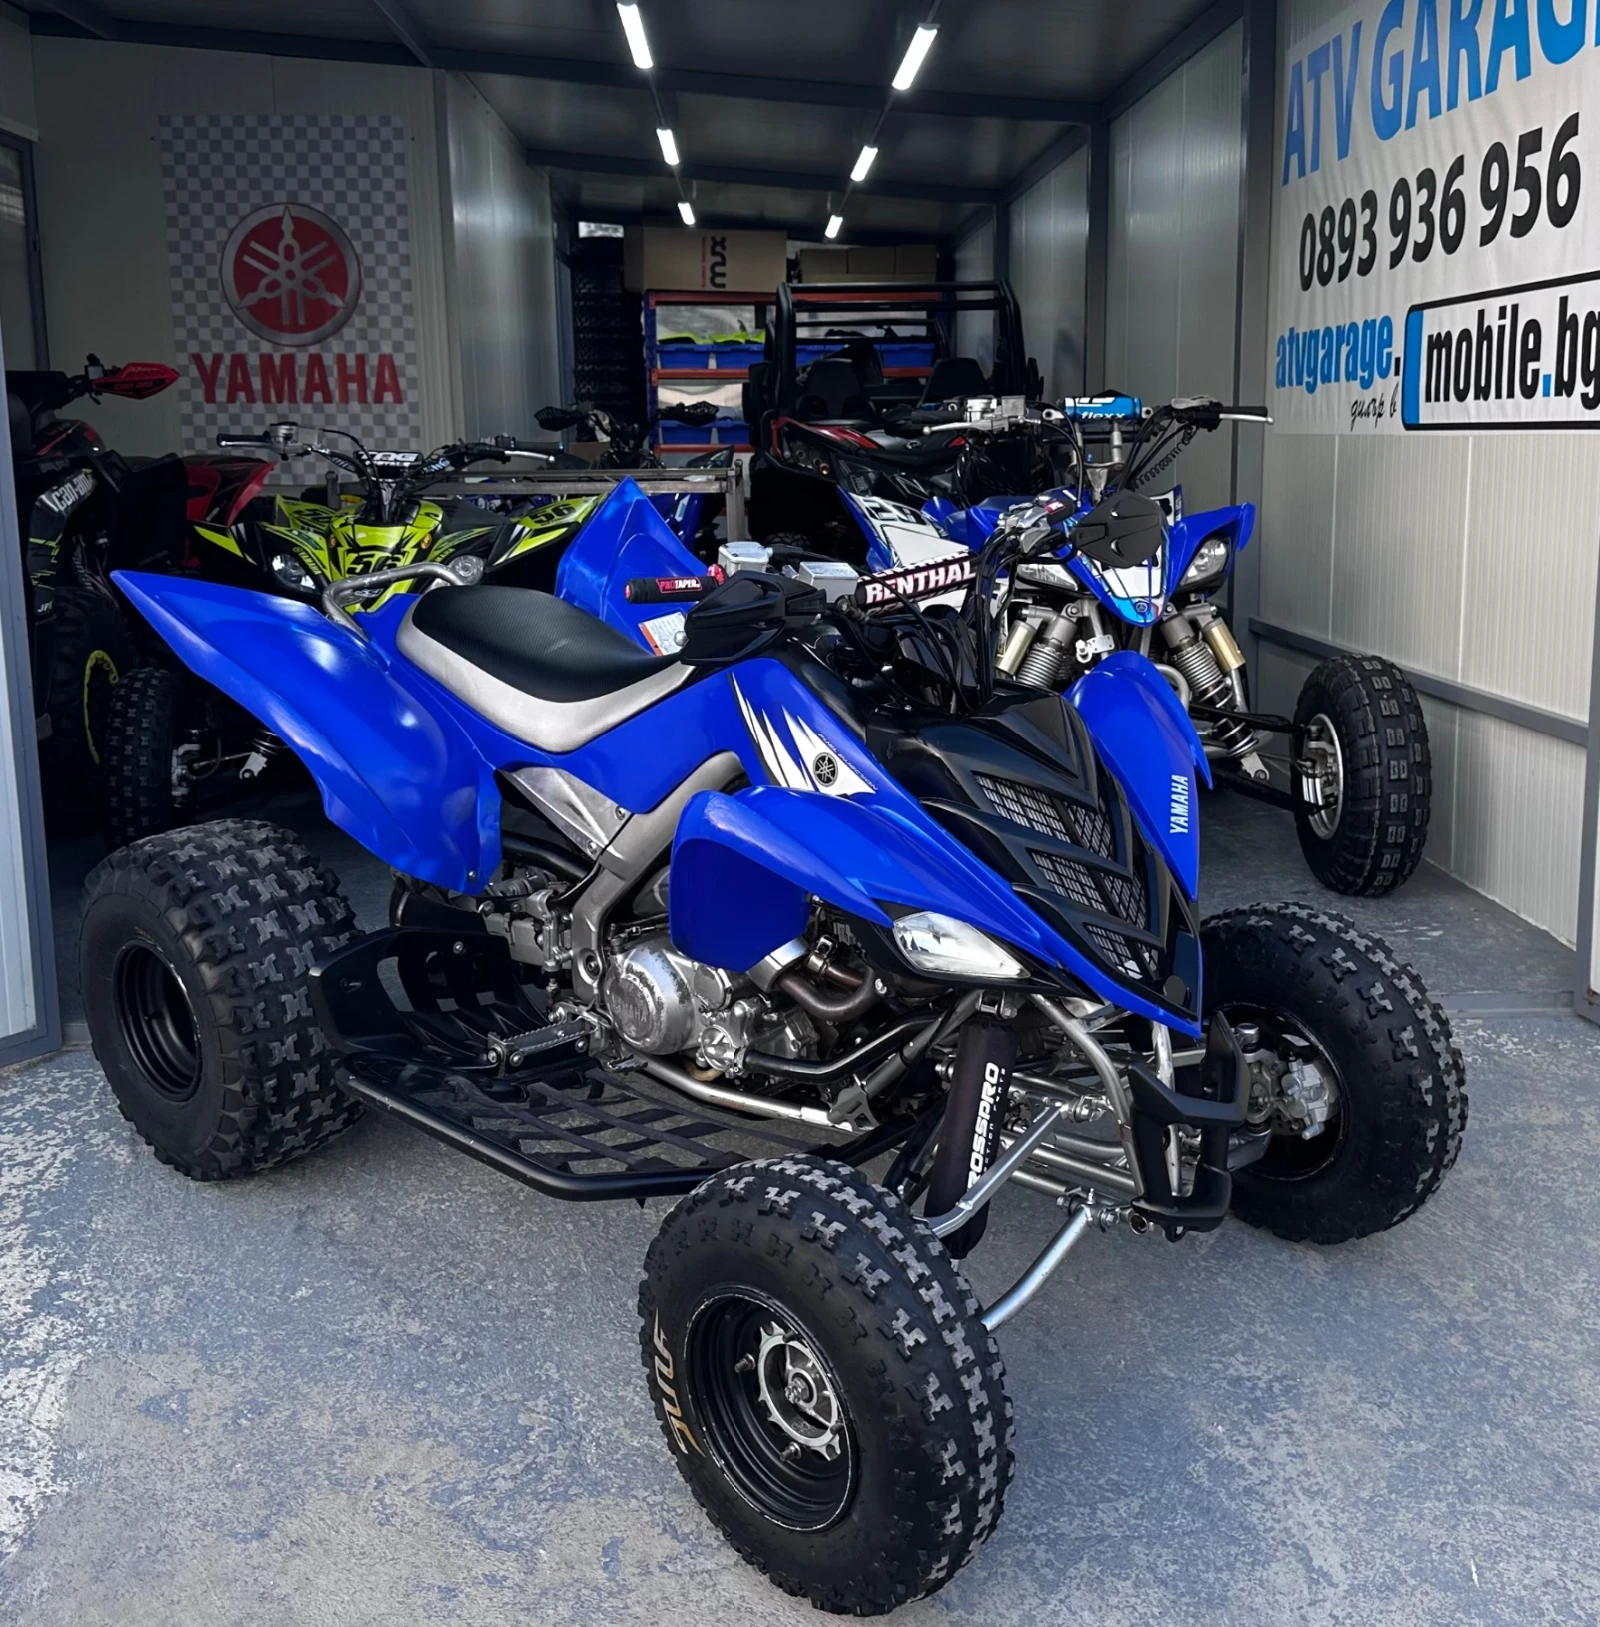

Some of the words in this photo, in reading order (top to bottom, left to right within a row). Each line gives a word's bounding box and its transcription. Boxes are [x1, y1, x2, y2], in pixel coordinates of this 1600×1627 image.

[1282, 19, 1363, 187] ATV
[1371, 0, 1600, 141] GARA
[1300, 189, 1378, 291] 0893
[1389, 154, 1466, 270] 936
[1480, 112, 1582, 247] 956
[191, 353, 404, 405] YAMAHA
[1425, 295, 1600, 410] mobile.bg
[357, 451, 420, 462] TAG
[528, 503, 577, 524] 56
[347, 551, 404, 576] 56
[864, 559, 977, 605] RENTHAL
[1170, 774, 1188, 834] YAMAHA
[967, 1061, 1000, 1189] ROSSPRO
